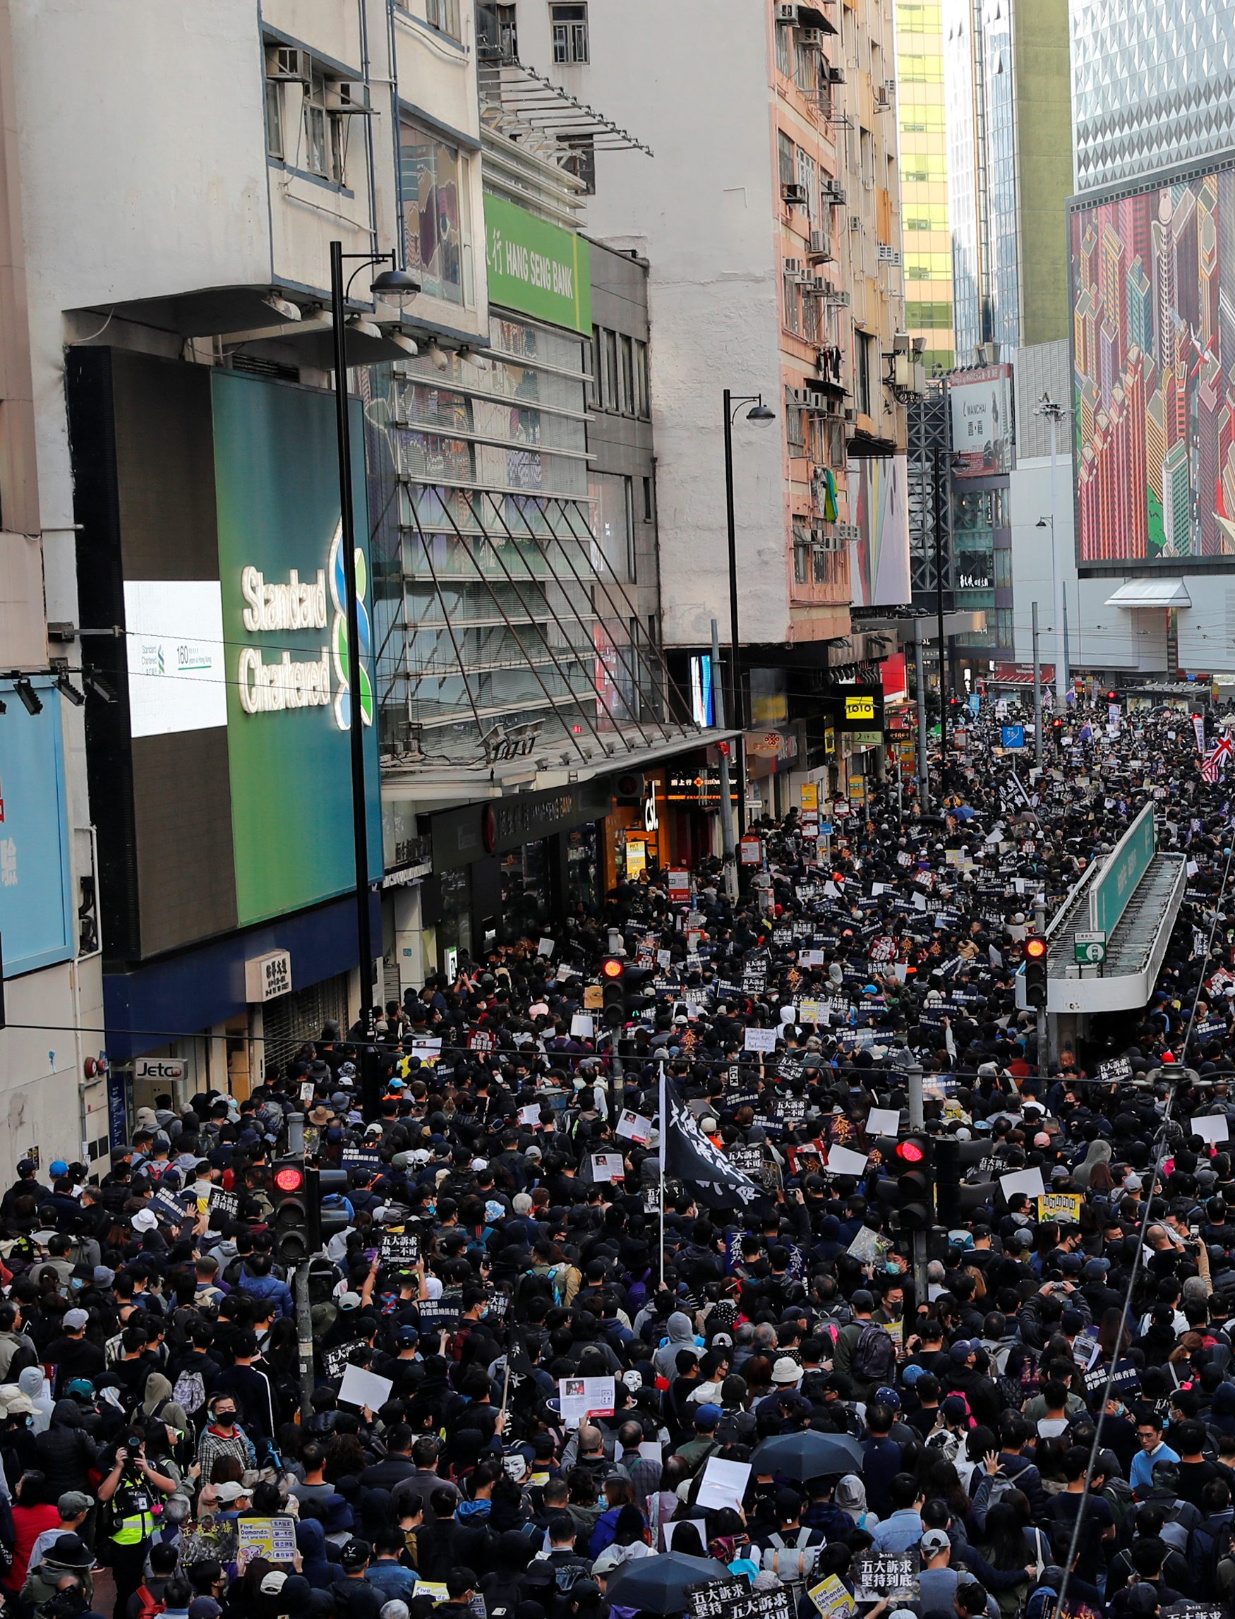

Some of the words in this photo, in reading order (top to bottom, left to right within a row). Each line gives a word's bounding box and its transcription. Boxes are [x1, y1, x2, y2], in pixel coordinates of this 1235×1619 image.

[506, 240, 528, 281] HANG
[530, 251, 551, 292] SENG
[552, 261, 573, 299] BANK
[242, 566, 327, 631] Standard
[239, 646, 331, 713] Chartered
[137, 1062, 182, 1077] Jetco
[382, 1236, 418, 1246] 五大訴求
[382, 1246, 418, 1257] 缺一不可
[861, 1560, 912, 1574] 五大訴求
[861, 1573, 912, 1588] 堅持到底
[692, 1584, 745, 1606] 五大訴求
[732, 1593, 787, 1619] 五大訴求
